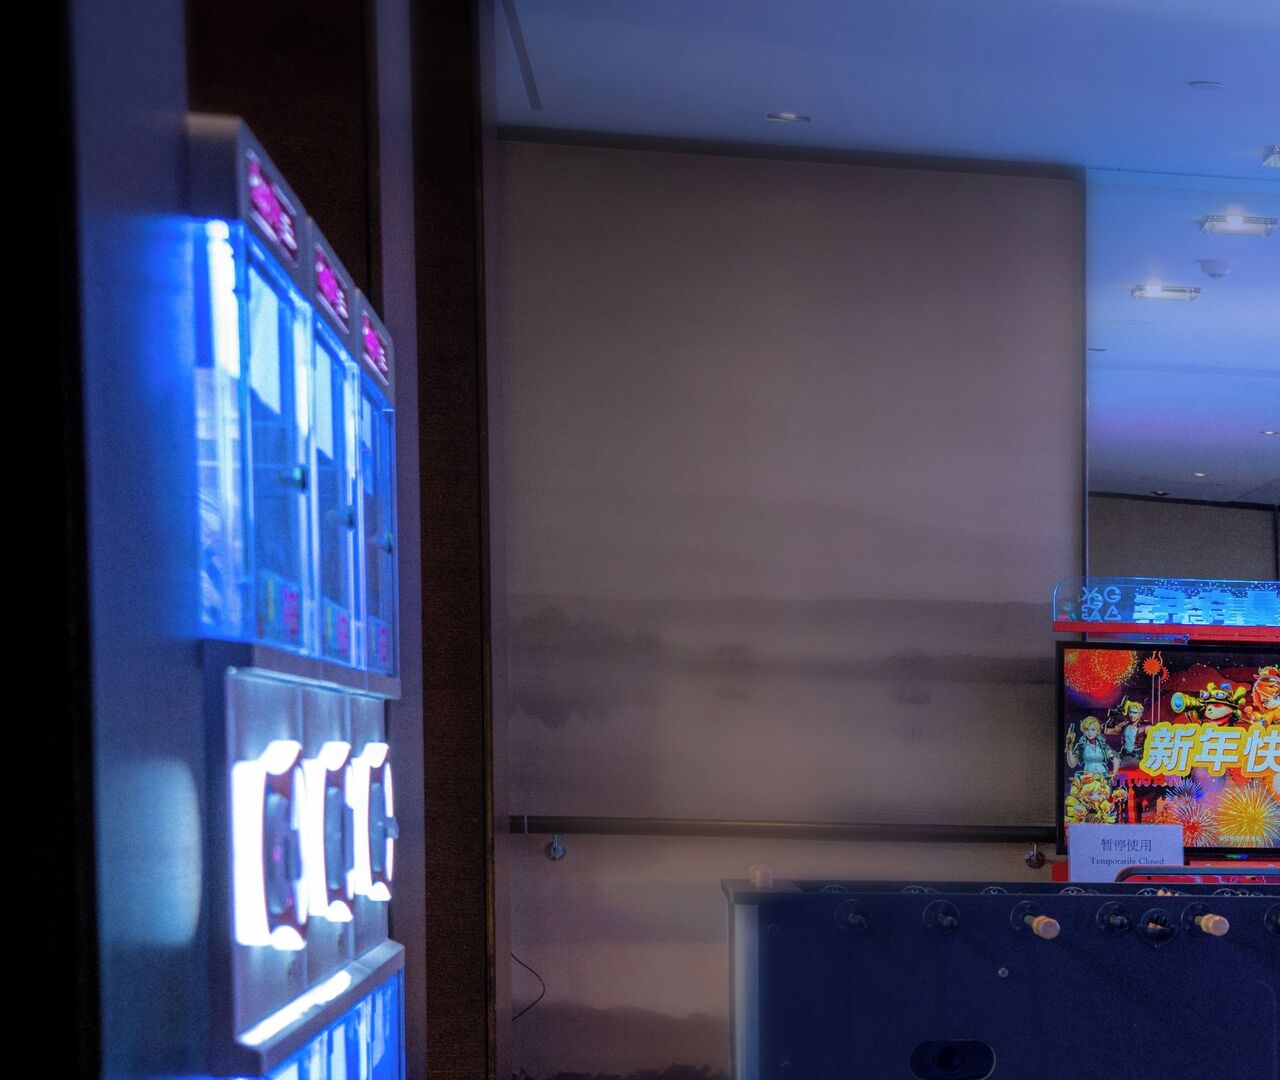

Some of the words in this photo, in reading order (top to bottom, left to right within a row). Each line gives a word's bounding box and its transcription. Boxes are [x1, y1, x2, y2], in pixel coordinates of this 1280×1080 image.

[1101, 838, 1152, 852] 暂停使用
[1090, 857, 1136, 866] Temporarily
[1138, 857, 1165, 866] Closed
